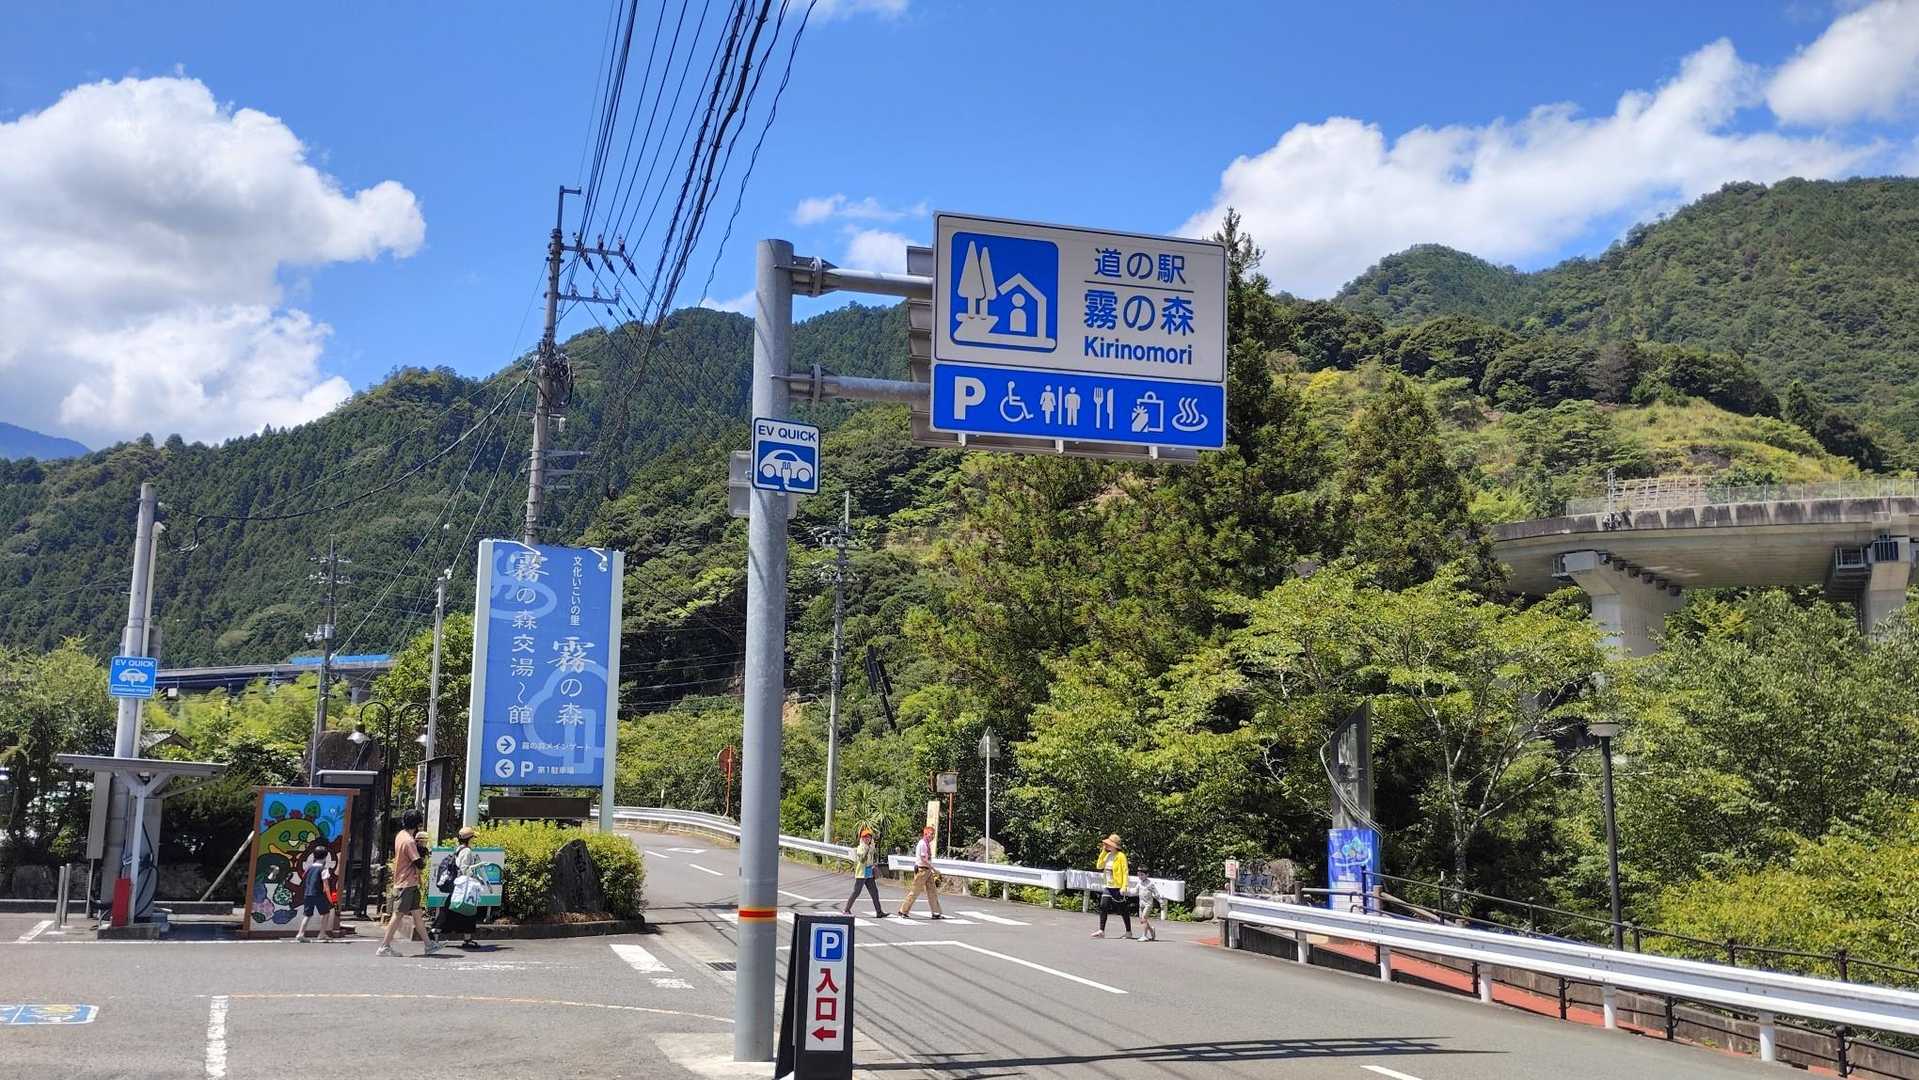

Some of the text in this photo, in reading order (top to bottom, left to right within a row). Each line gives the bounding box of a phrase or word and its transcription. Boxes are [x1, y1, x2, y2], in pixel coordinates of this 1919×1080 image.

[1094, 247, 1186, 285] 道の駅
[1083, 289, 1195, 336] 霧の森
[1083, 336, 1192, 365] Kirinomori
[954, 375, 986, 420] P
[758, 424, 816, 442] EV QUICK
[569, 555, 583, 626] 文化いこいの里
[545, 636, 596, 726] 霧の森
[520, 761, 534, 778] P
[821, 931, 840, 958] P
[815, 967, 839, 1021] 入口
